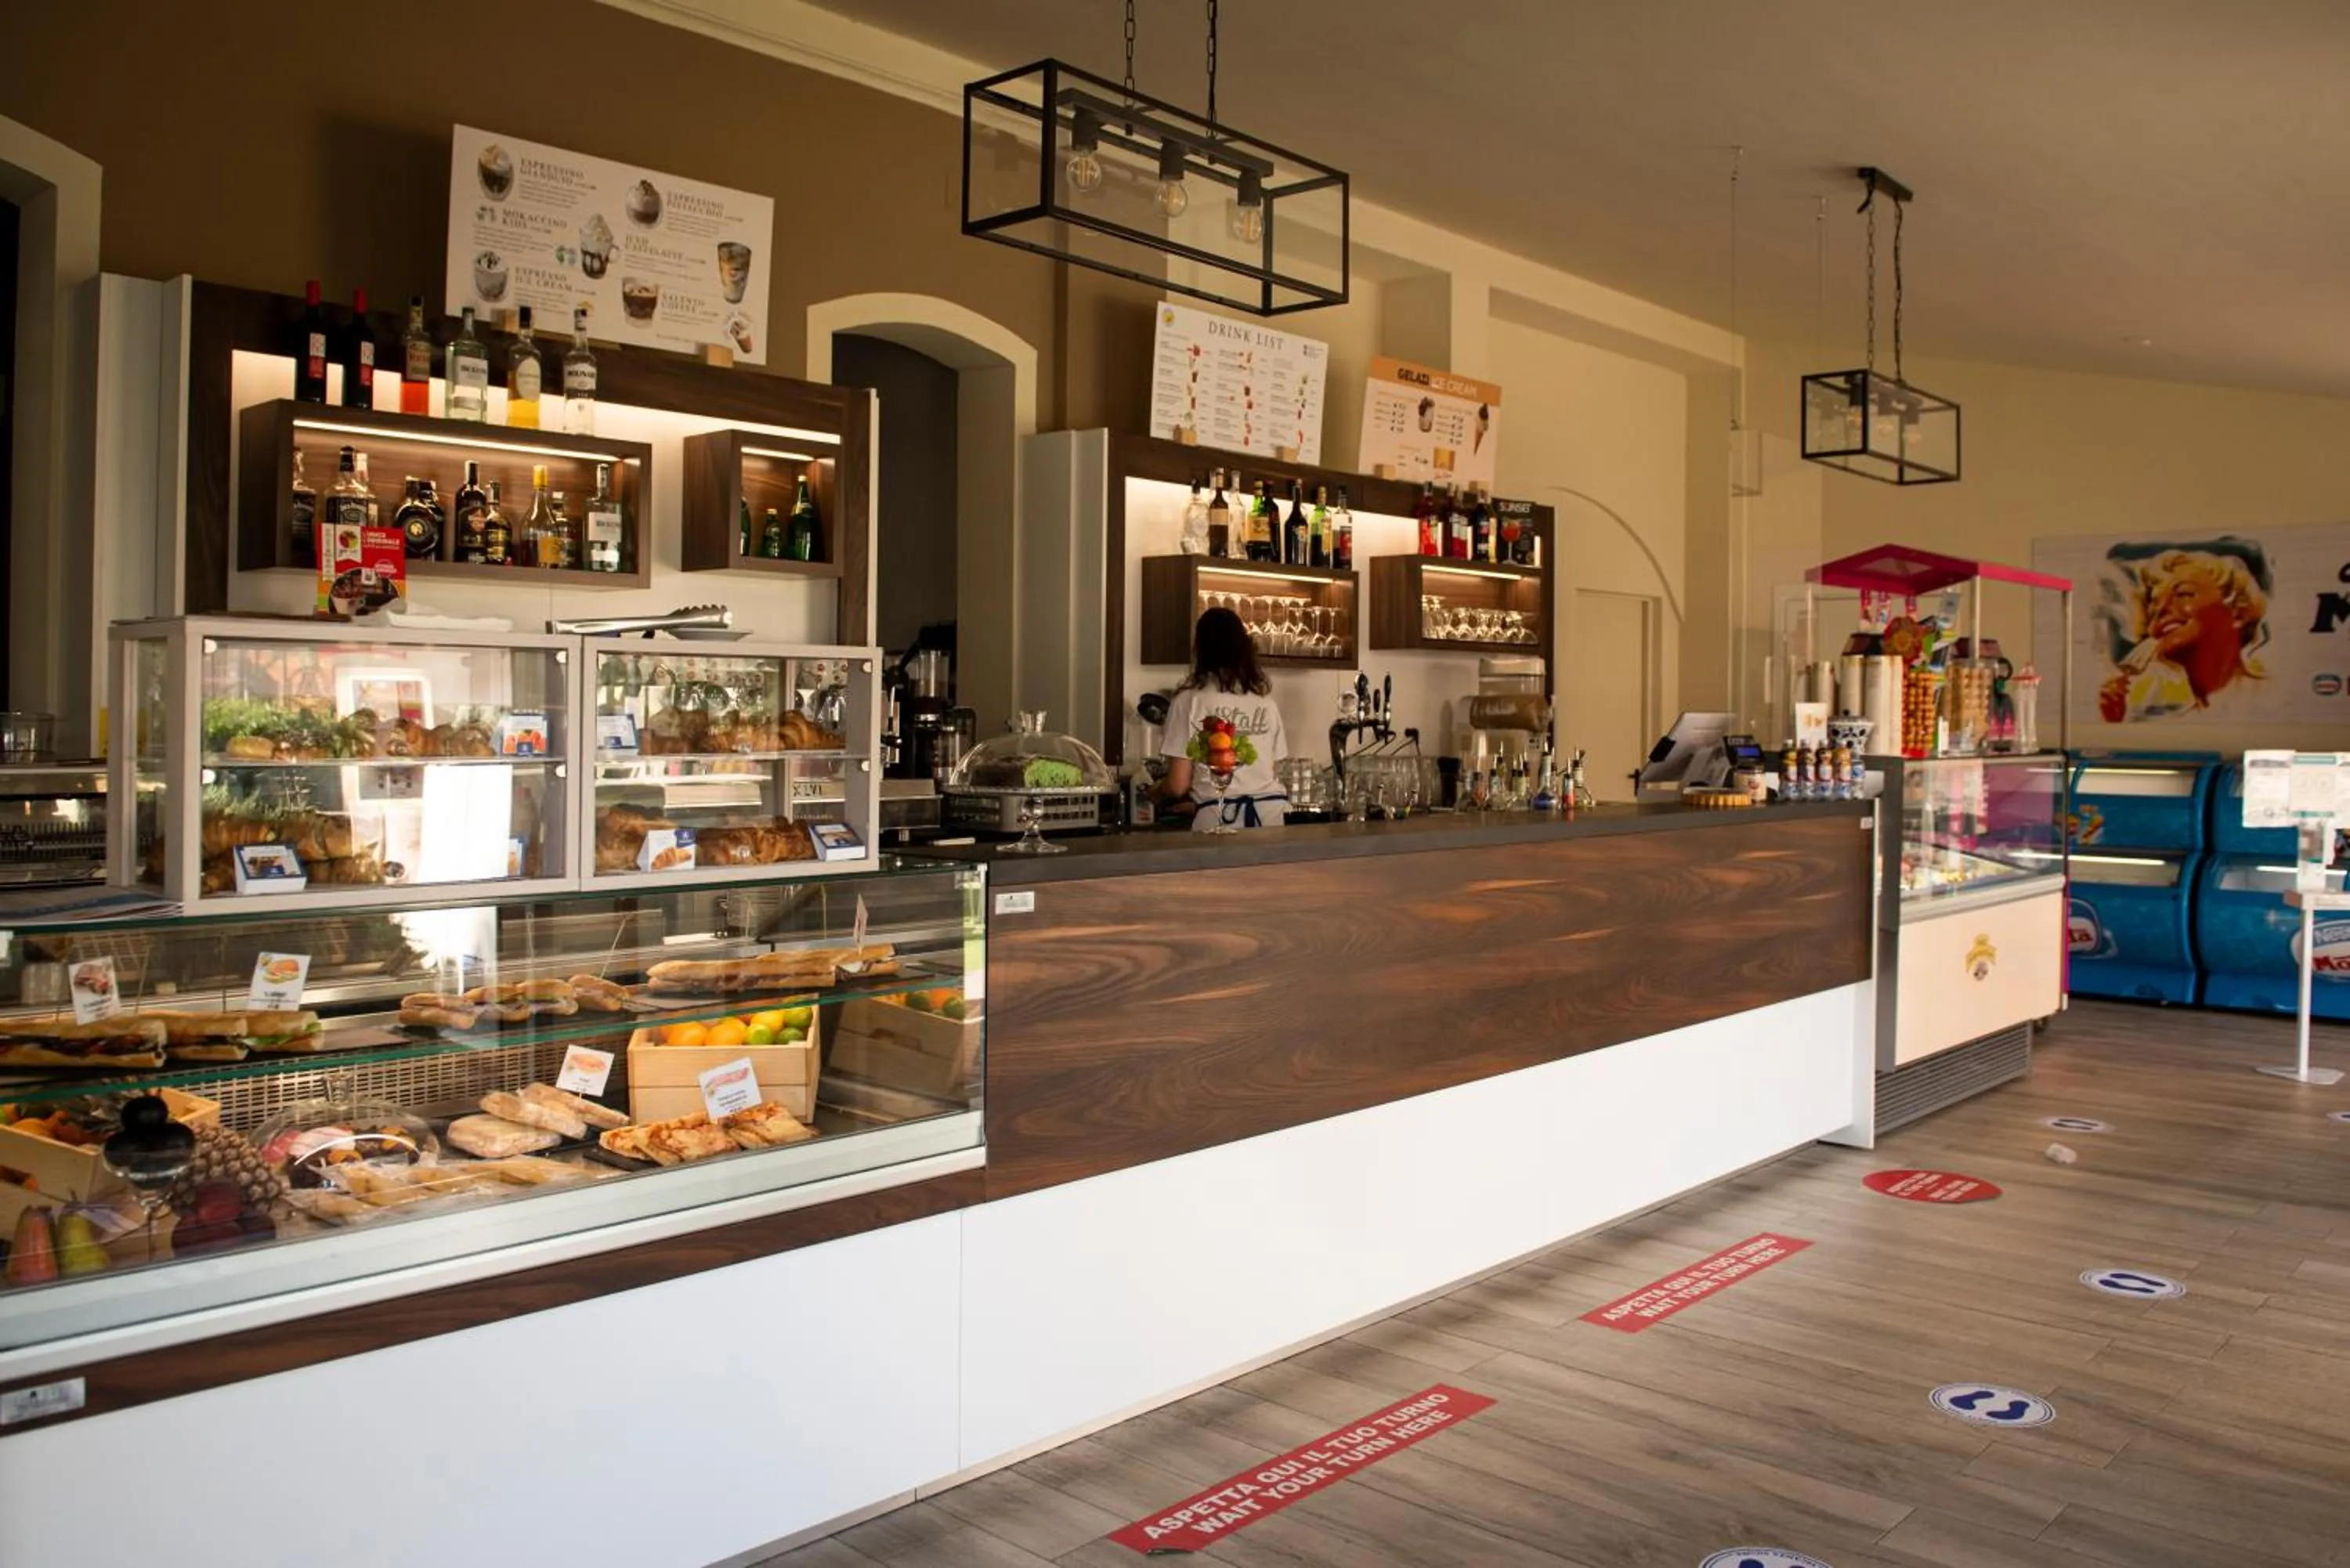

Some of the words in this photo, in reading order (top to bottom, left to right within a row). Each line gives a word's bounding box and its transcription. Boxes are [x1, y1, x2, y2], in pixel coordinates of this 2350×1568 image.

[1209, 320, 1250, 343] DRINK
[1256, 331, 1284, 351] LIST
[1215, 706, 1271, 735] Staff
[1601, 1289, 1672, 1321] ASPETTA
[1663, 1276, 1697, 1290] QUI
[1701, 1257, 1737, 1271] TUO
[1728, 1238, 1777, 1258] TURNO
[1635, 1298, 1680, 1317] WAIT
[1672, 1279, 1720, 1299] YOUR
[1708, 1263, 1754, 1281] TURN
[1744, 1248, 1787, 1265] HERE
[1143, 1483, 1260, 1539] ASPETTA
[1256, 1459, 1307, 1483] QUI
[1300, 1450, 1332, 1462] IL
[1325, 1426, 1379, 1450] TUO
[1372, 1393, 1451, 1428] TURNO
[1190, 1498, 1263, 1534] WAIT
[1258, 1466, 1335, 1499] YOUR
[1325, 1436, 1397, 1468] TURN
[1389, 1410, 1454, 1440] HERE
